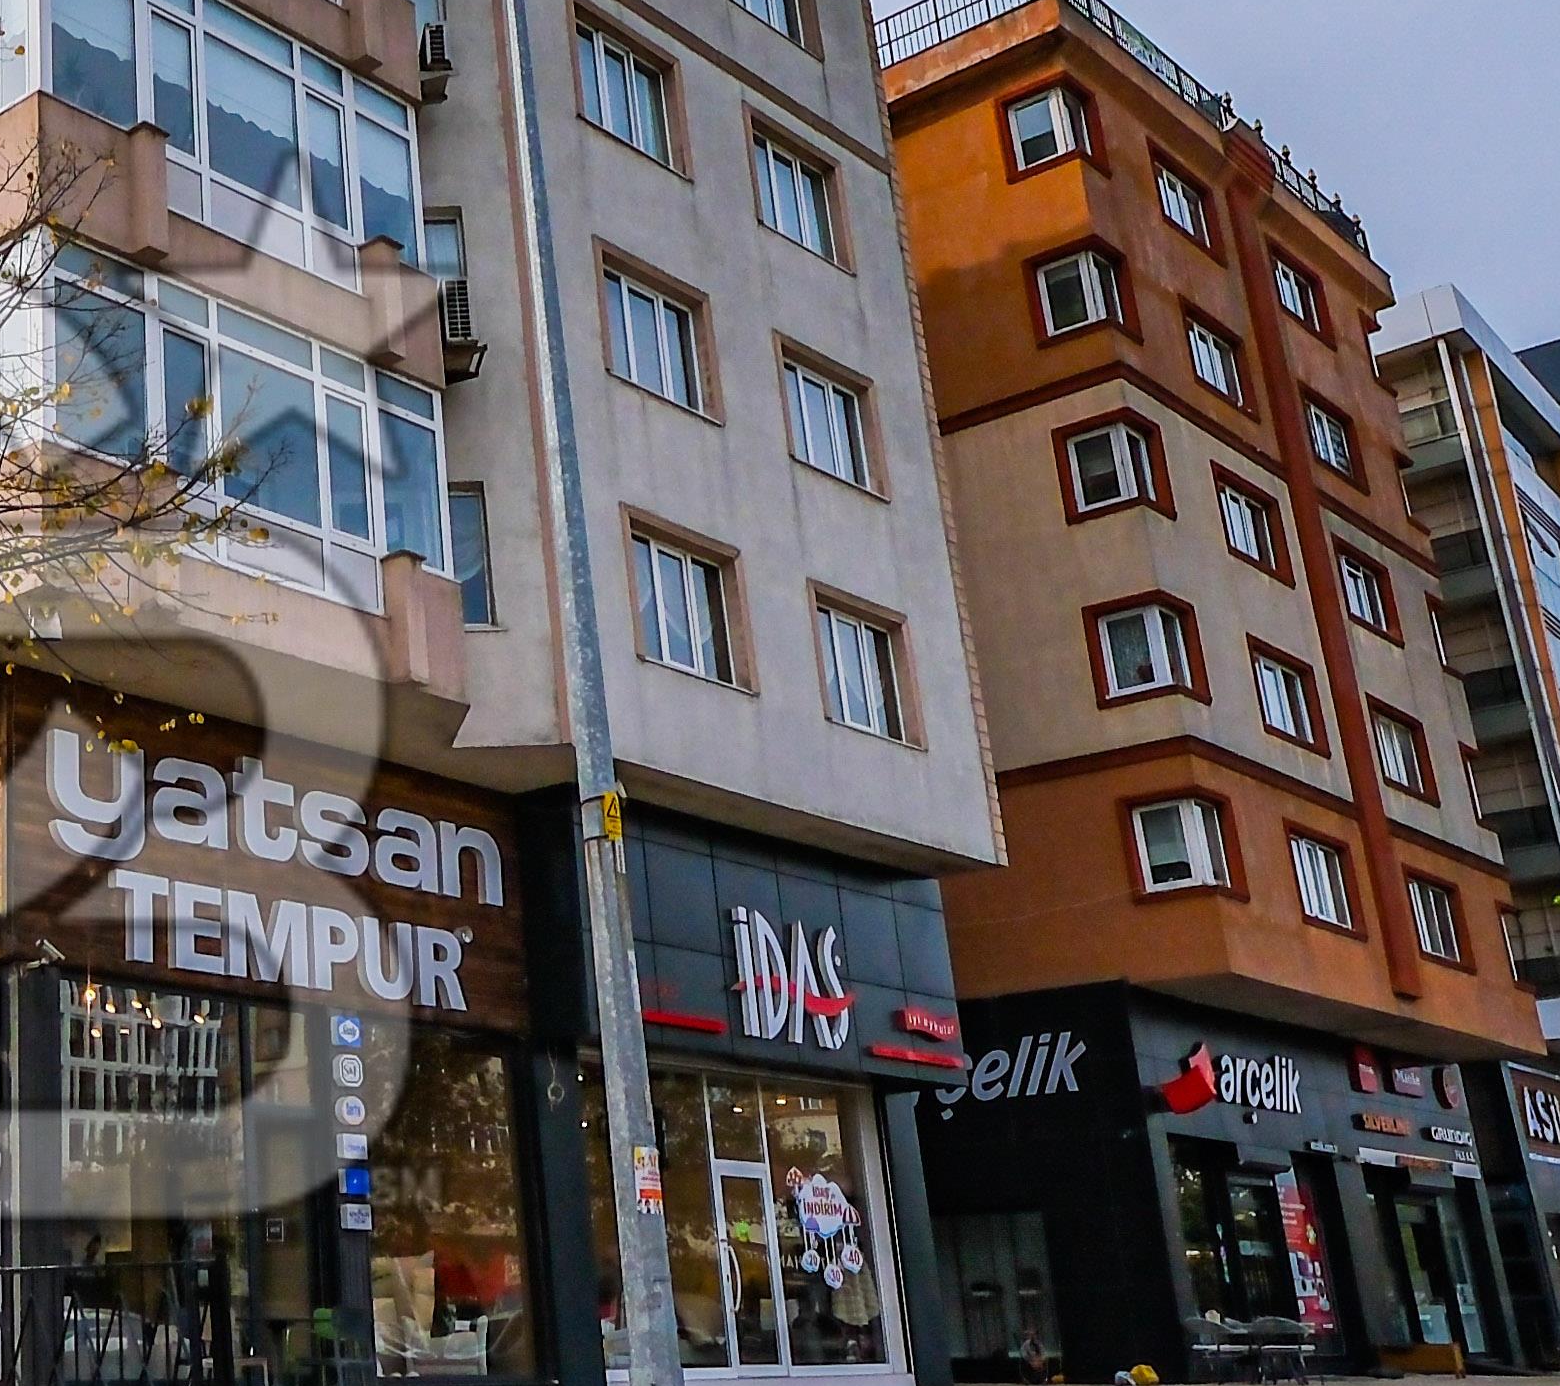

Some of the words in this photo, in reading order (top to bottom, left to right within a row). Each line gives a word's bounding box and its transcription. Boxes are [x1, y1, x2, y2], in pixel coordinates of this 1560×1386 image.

[48, 728, 504, 906] yatsan
[112, 869, 467, 1011] TEMPUR
[1220, 1054, 1302, 1124] arçelik
